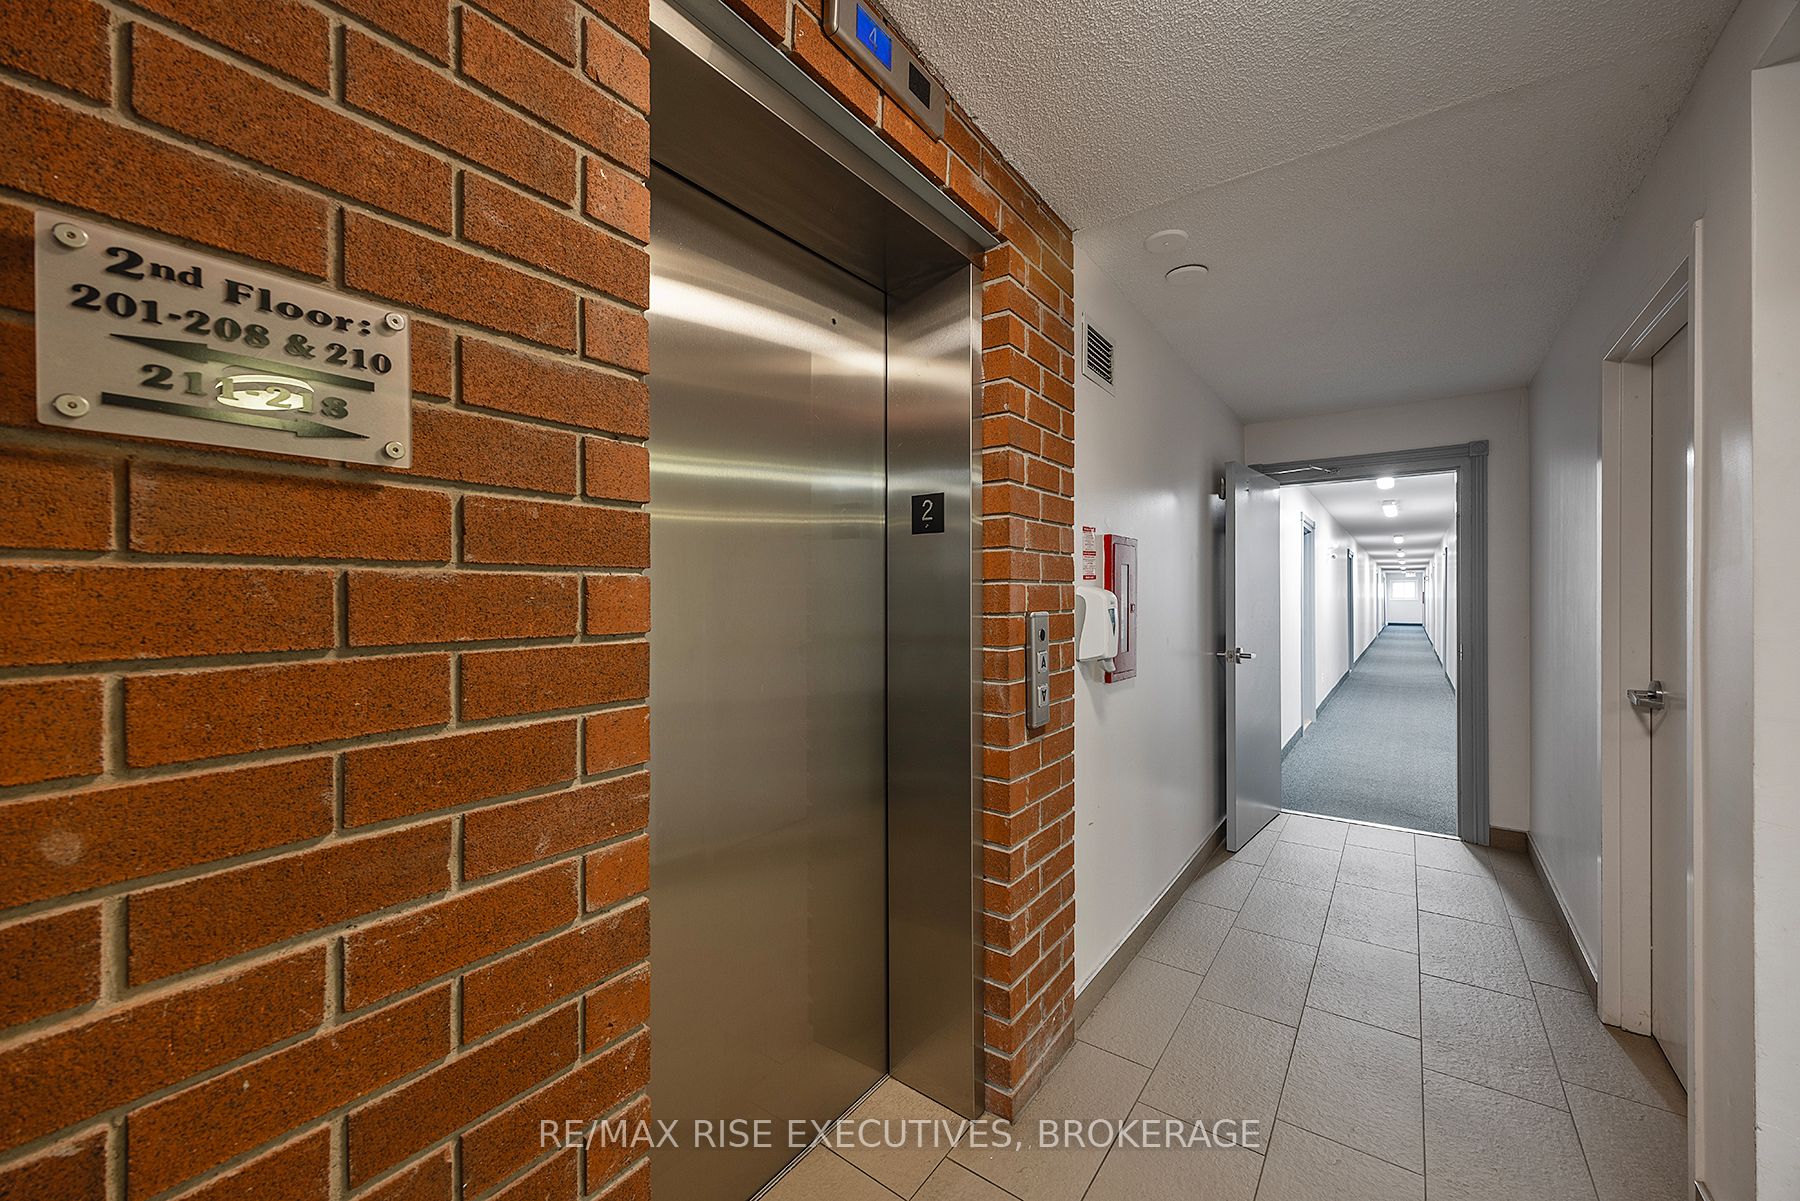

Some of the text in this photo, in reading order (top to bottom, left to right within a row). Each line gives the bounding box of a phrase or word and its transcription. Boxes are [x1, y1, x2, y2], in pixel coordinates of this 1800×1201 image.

[105, 246, 373, 335] 2nd Floor:
[70, 283, 393, 375] 201-208 & 210
[141, 363, 349, 420] 211-218
[921, 499, 934, 522] 2
